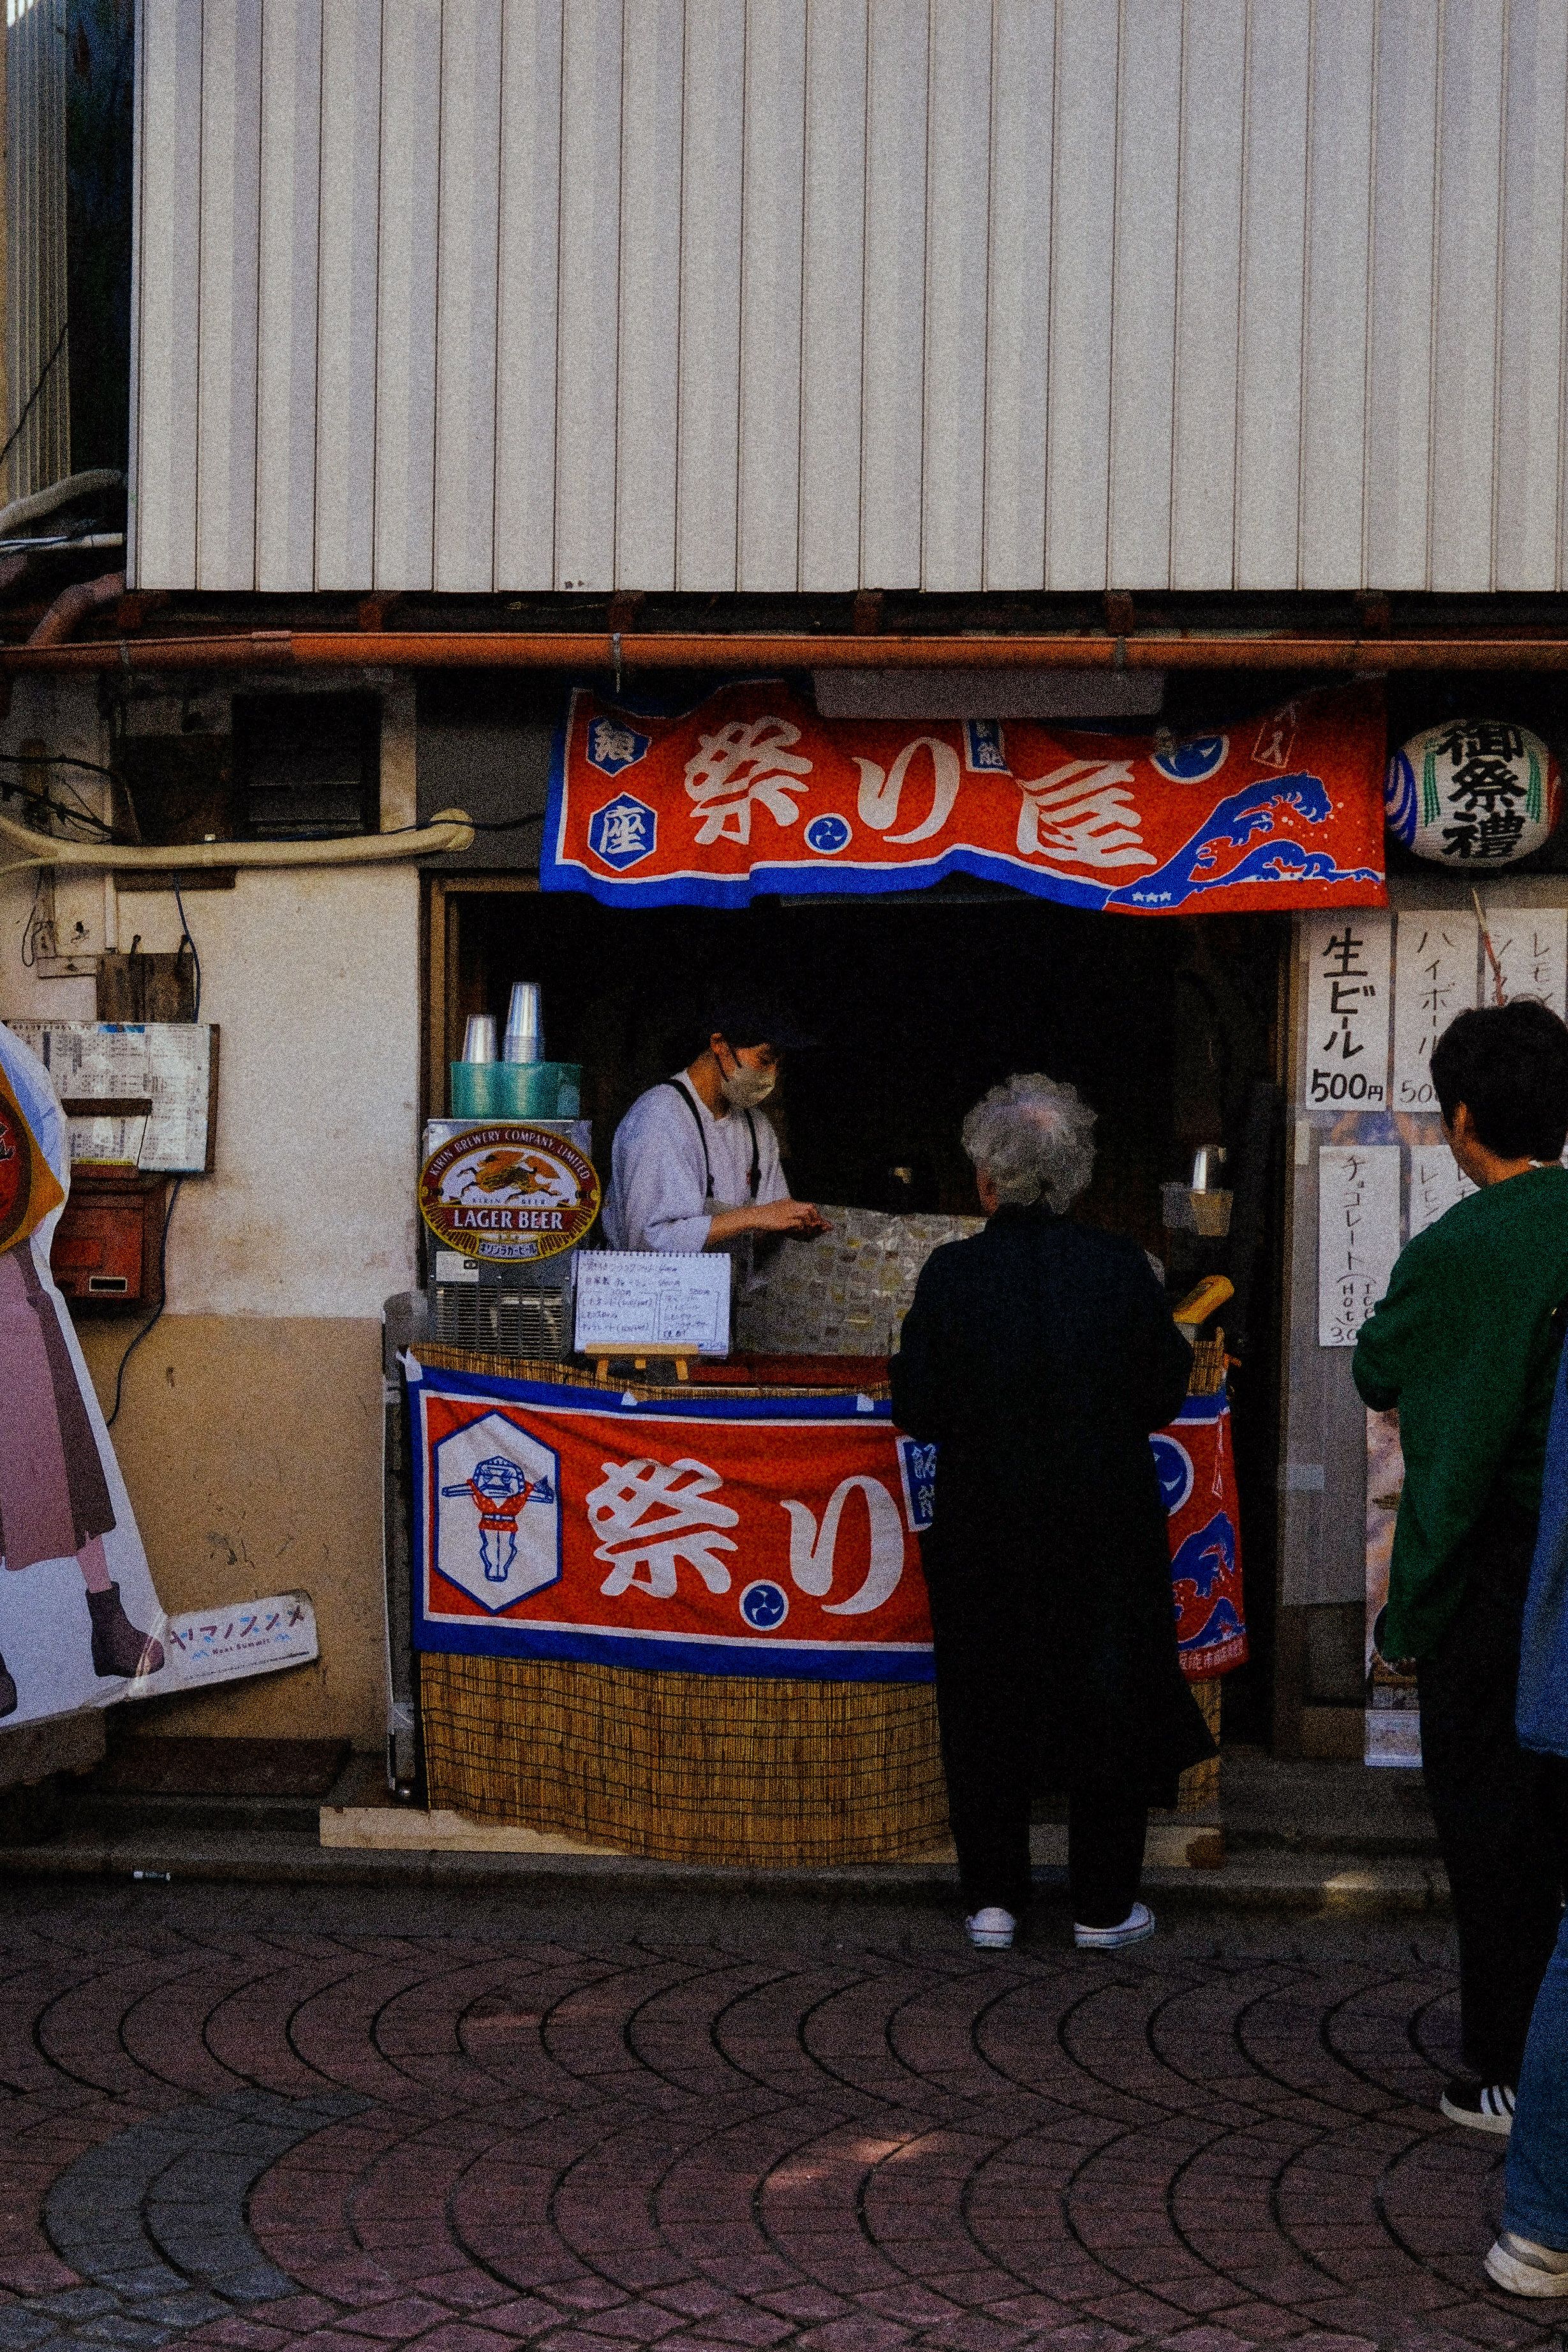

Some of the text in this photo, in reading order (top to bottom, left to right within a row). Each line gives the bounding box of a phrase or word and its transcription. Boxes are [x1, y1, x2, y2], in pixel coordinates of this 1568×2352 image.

[1322, 927, 1375, 1060] 生ビール
[1311, 1069, 1383, 1102] 500円
[429, 1150, 454, 1176] KIRIN
[454, 1130, 500, 1153] BREWERY
[557, 1146, 590, 1180] LIMITED
[454, 1209, 563, 1230] LAGER BEER
